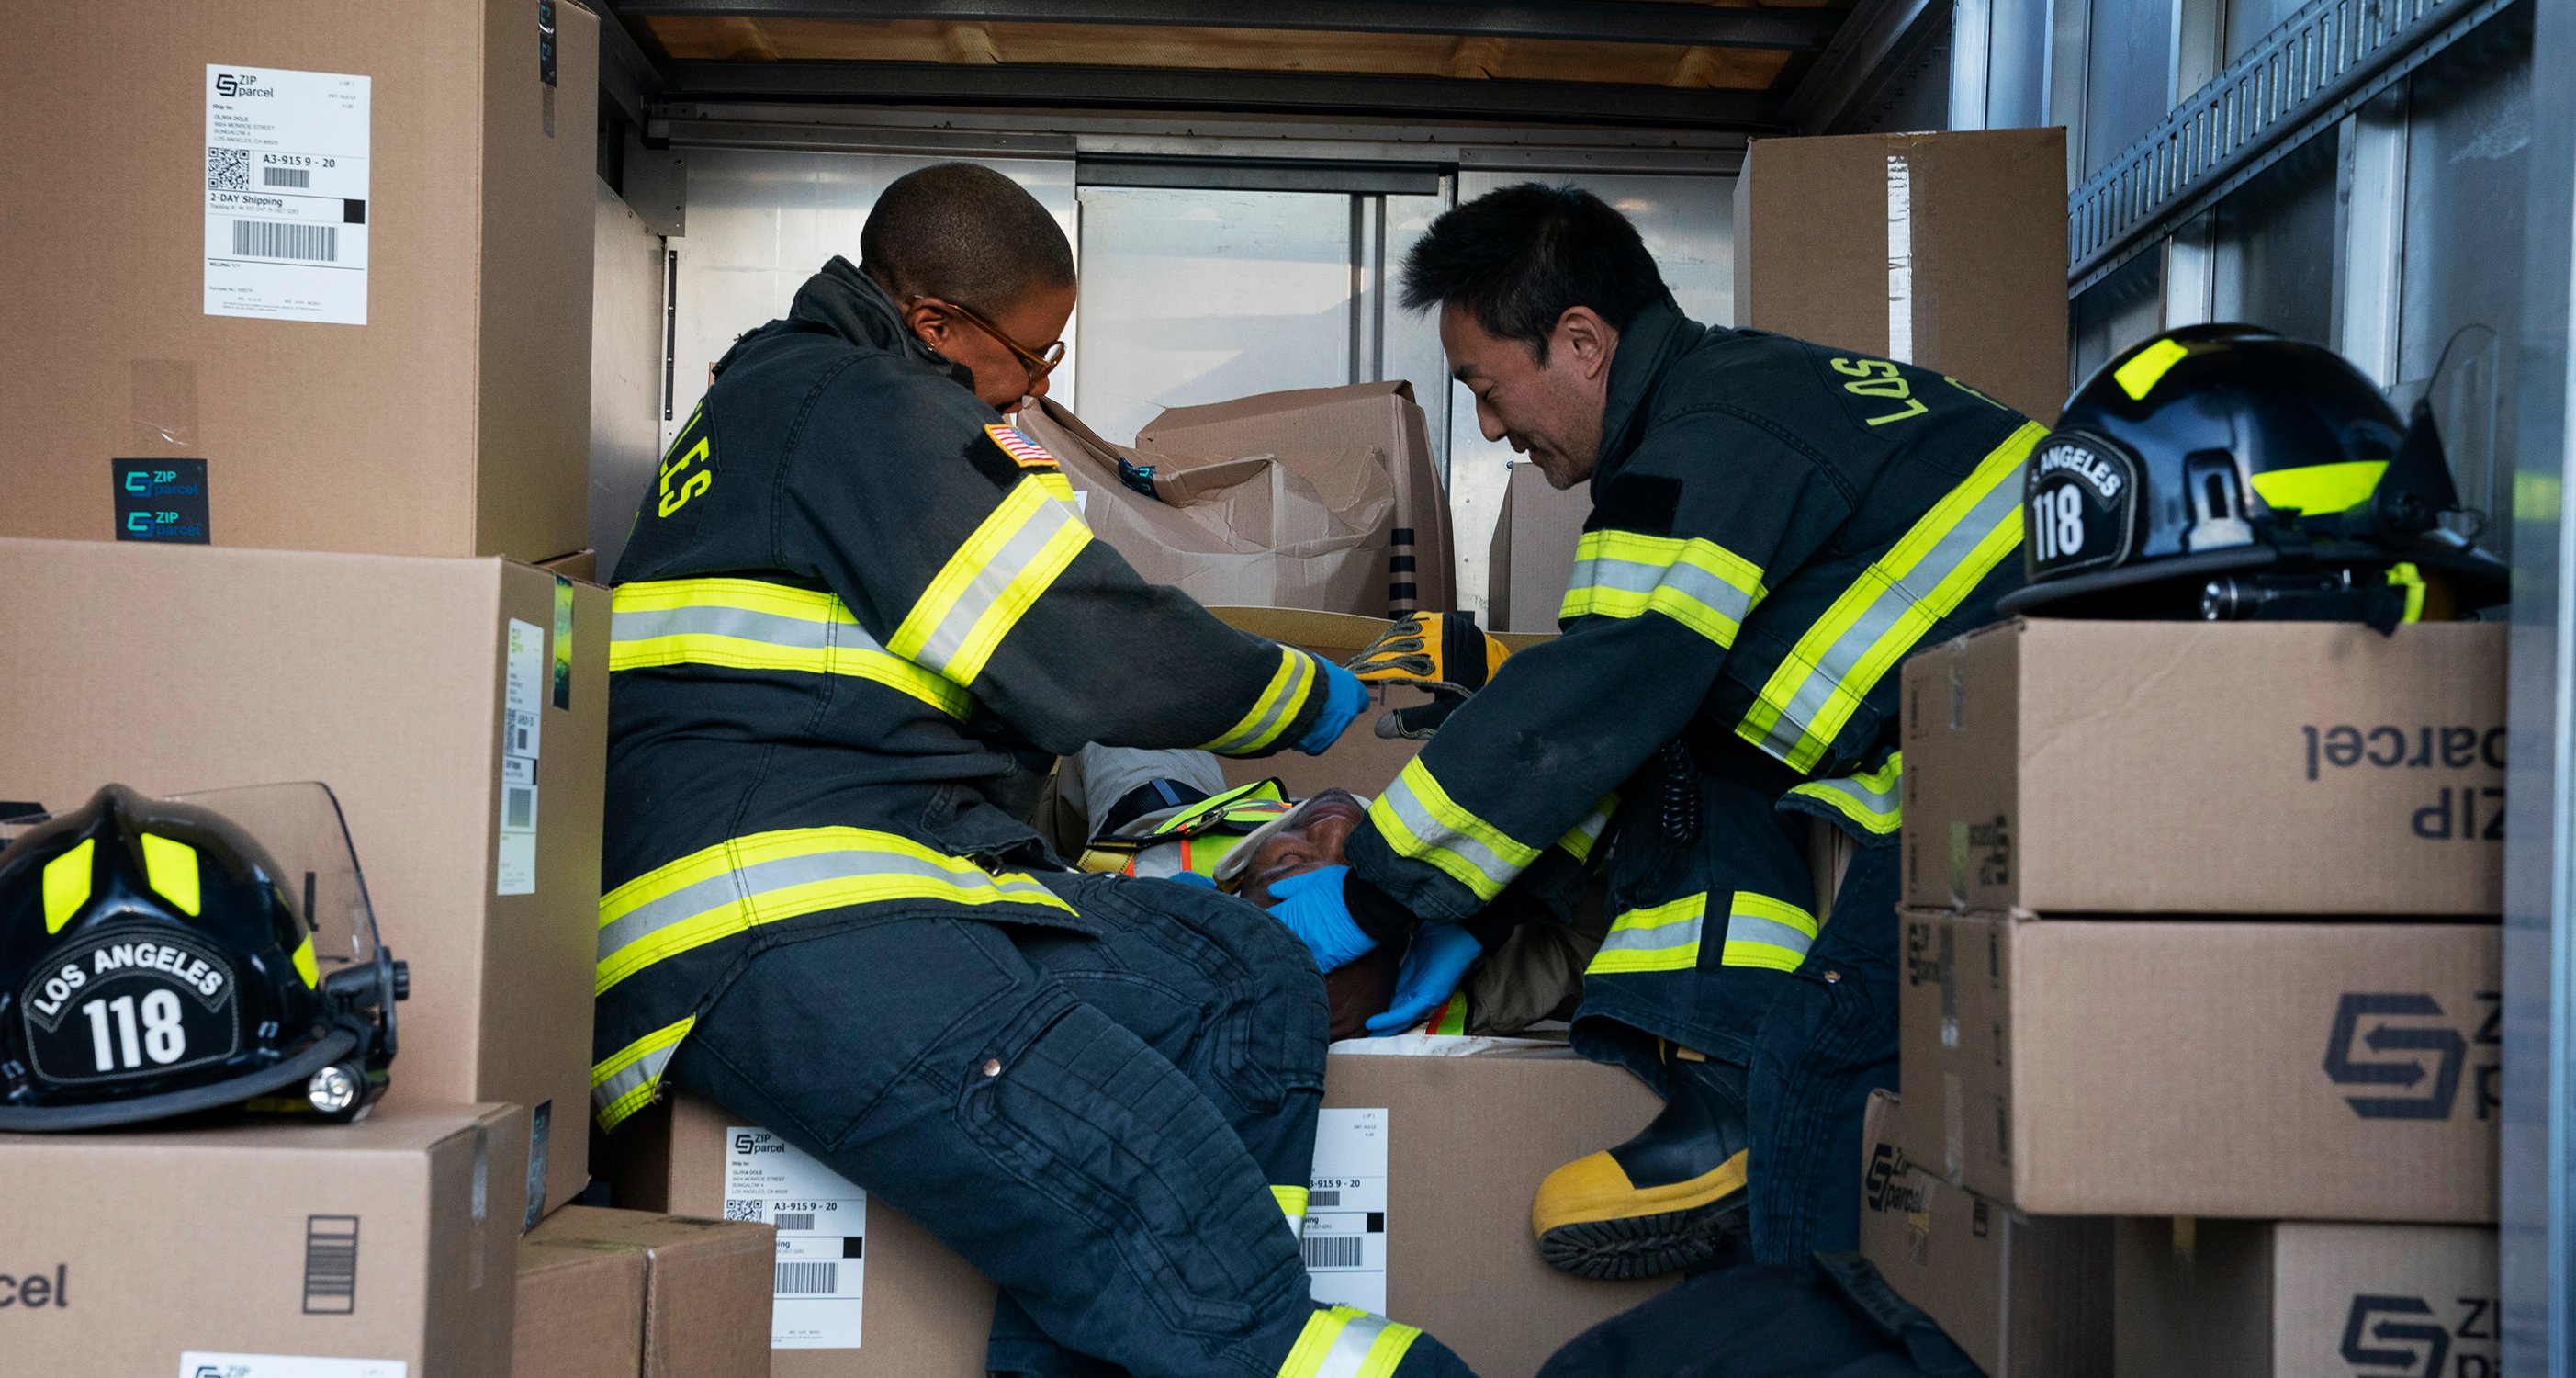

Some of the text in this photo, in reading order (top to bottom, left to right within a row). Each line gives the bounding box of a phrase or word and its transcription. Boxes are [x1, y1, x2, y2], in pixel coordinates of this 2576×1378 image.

[239, 74, 257, 85] ZIP
[238, 85, 274, 99] parcel
[263, 153, 301, 166] A3-915
[305, 155, 311, 166] 9
[322, 158, 336, 168] 20
[210, 193, 283, 208] 2-DAY Shipping
[1830, 357, 1929, 426] LOS
[153, 470, 176, 483] ZIP
[2040, 445, 2122, 498] ANGELES
[154, 483, 199, 497] parcel
[155, 511, 179, 524] ZIP
[2032, 483, 2085, 562] 118
[156, 524, 201, 537] parcel
[34, 943, 224, 1016] LOS ANGELES
[83, 988, 186, 1072] 118
[755, 1134, 771, 1143] ZIP
[754, 1142, 785, 1154] parcel
[1310, 1179, 1333, 1188] 3-915
[1335, 1179, 1341, 1188] 9
[1350, 1179, 1360, 1188] 20
[774, 1202, 807, 1212] A3-915
[810, 1203, 816, 1212] 9
[826, 1202, 837, 1212] 20
